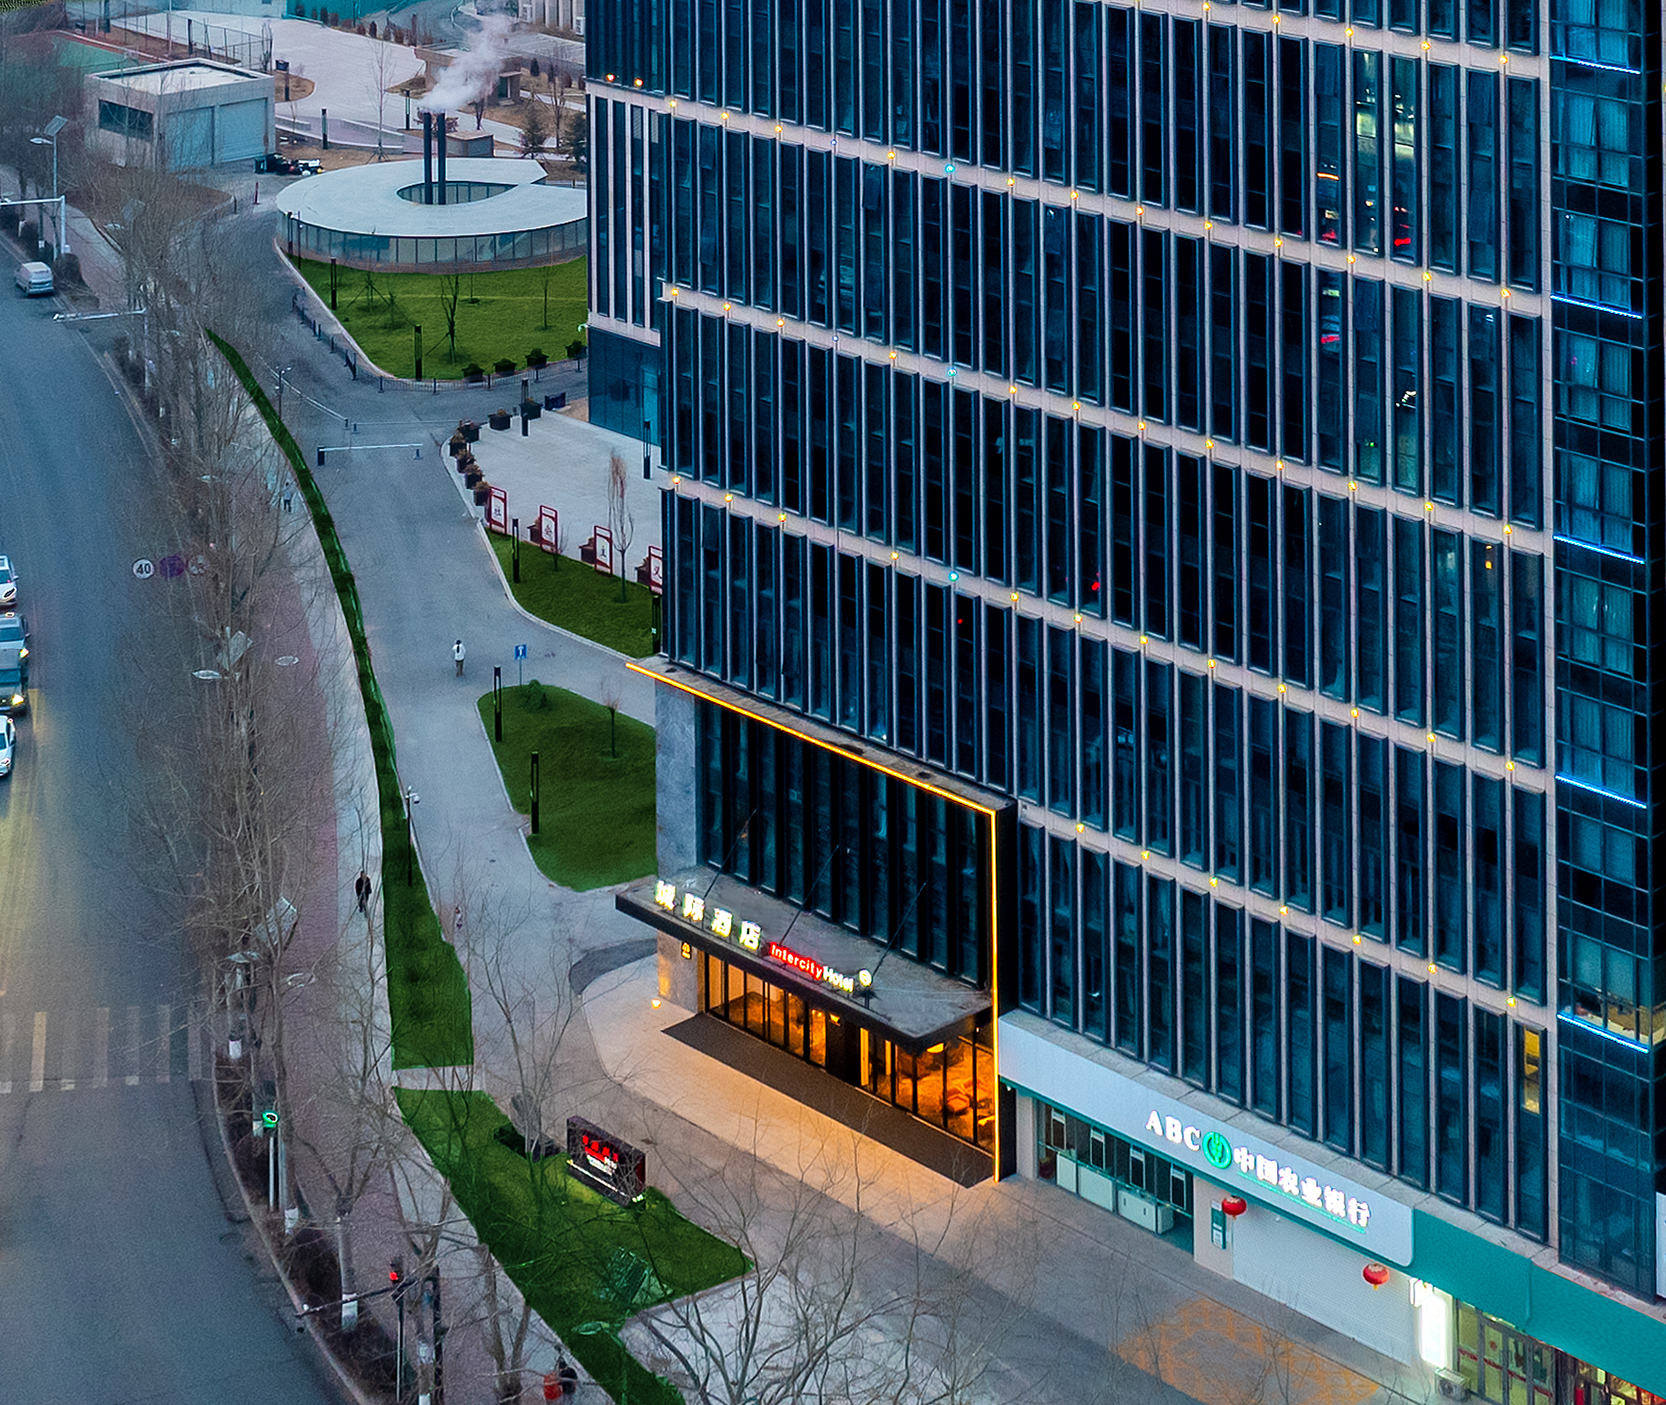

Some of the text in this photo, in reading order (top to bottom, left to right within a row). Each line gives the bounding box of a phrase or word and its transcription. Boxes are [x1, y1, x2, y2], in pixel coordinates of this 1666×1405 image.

[136, 563, 151, 574] 40
[654, 879, 763, 952] 城际酒店
[1145, 1109, 1371, 1228] ABC 中国农业银行
